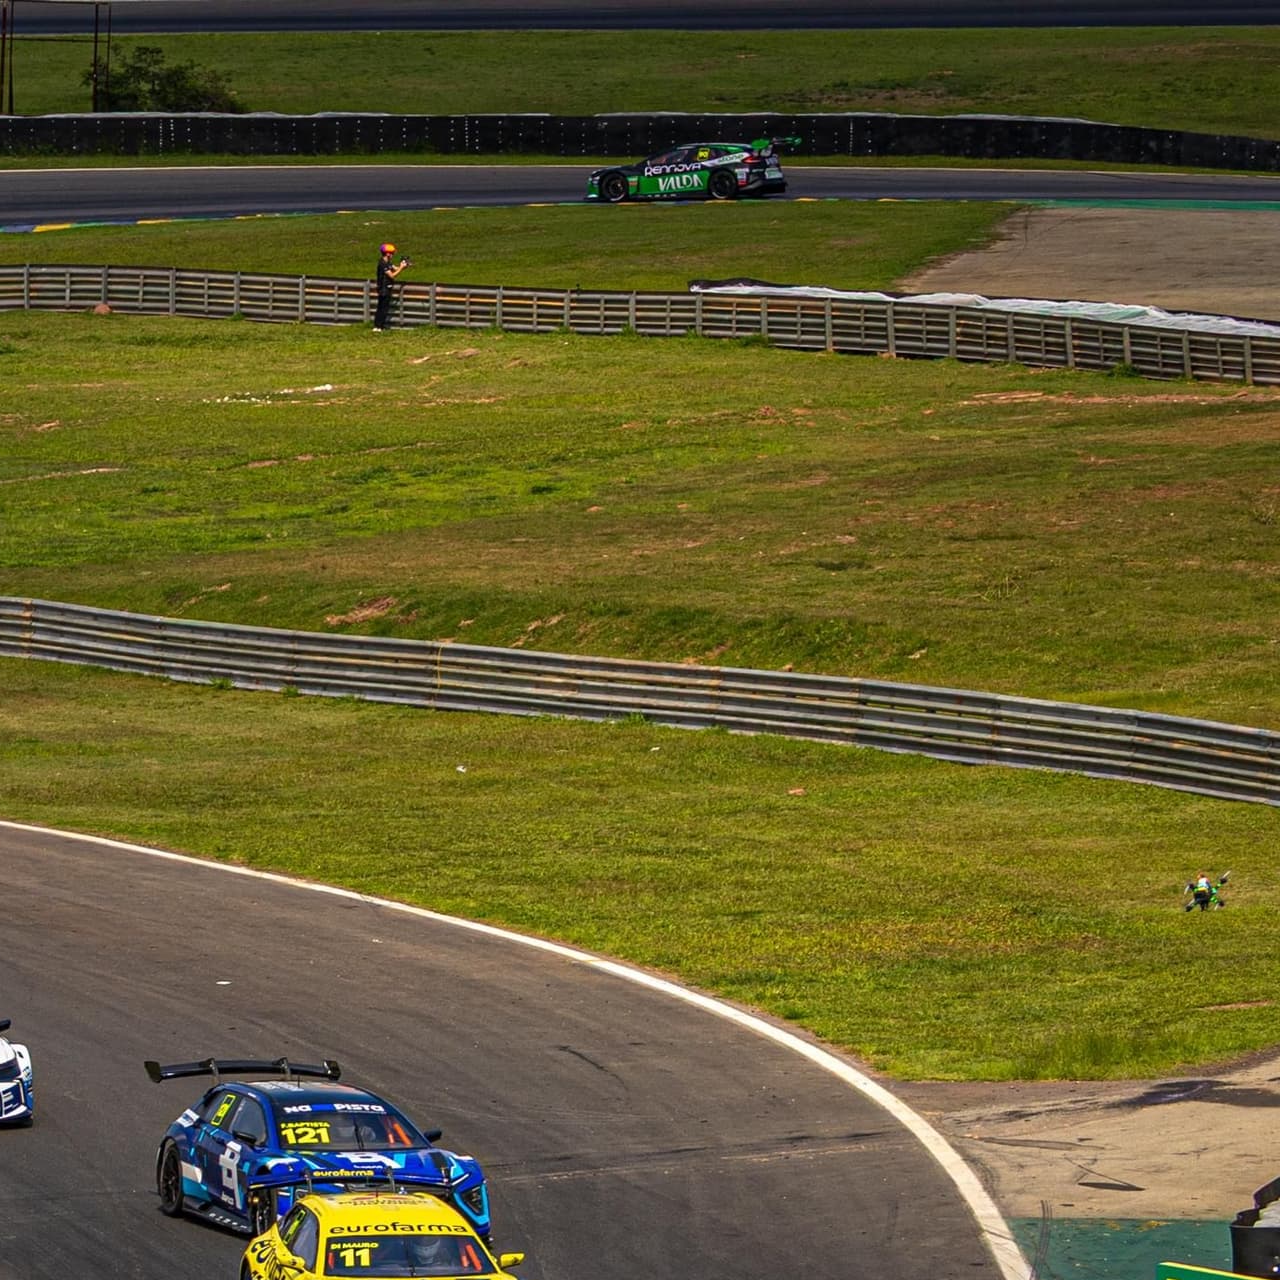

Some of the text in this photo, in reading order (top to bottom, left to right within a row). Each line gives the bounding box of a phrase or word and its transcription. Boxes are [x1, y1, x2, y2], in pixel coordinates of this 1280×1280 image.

[281, 1127, 331, 1145] 121
[313, 1168, 374, 1177] eurofarma
[330, 1221, 468, 1234] eurofarma
[340, 1248, 371, 1267] 11
